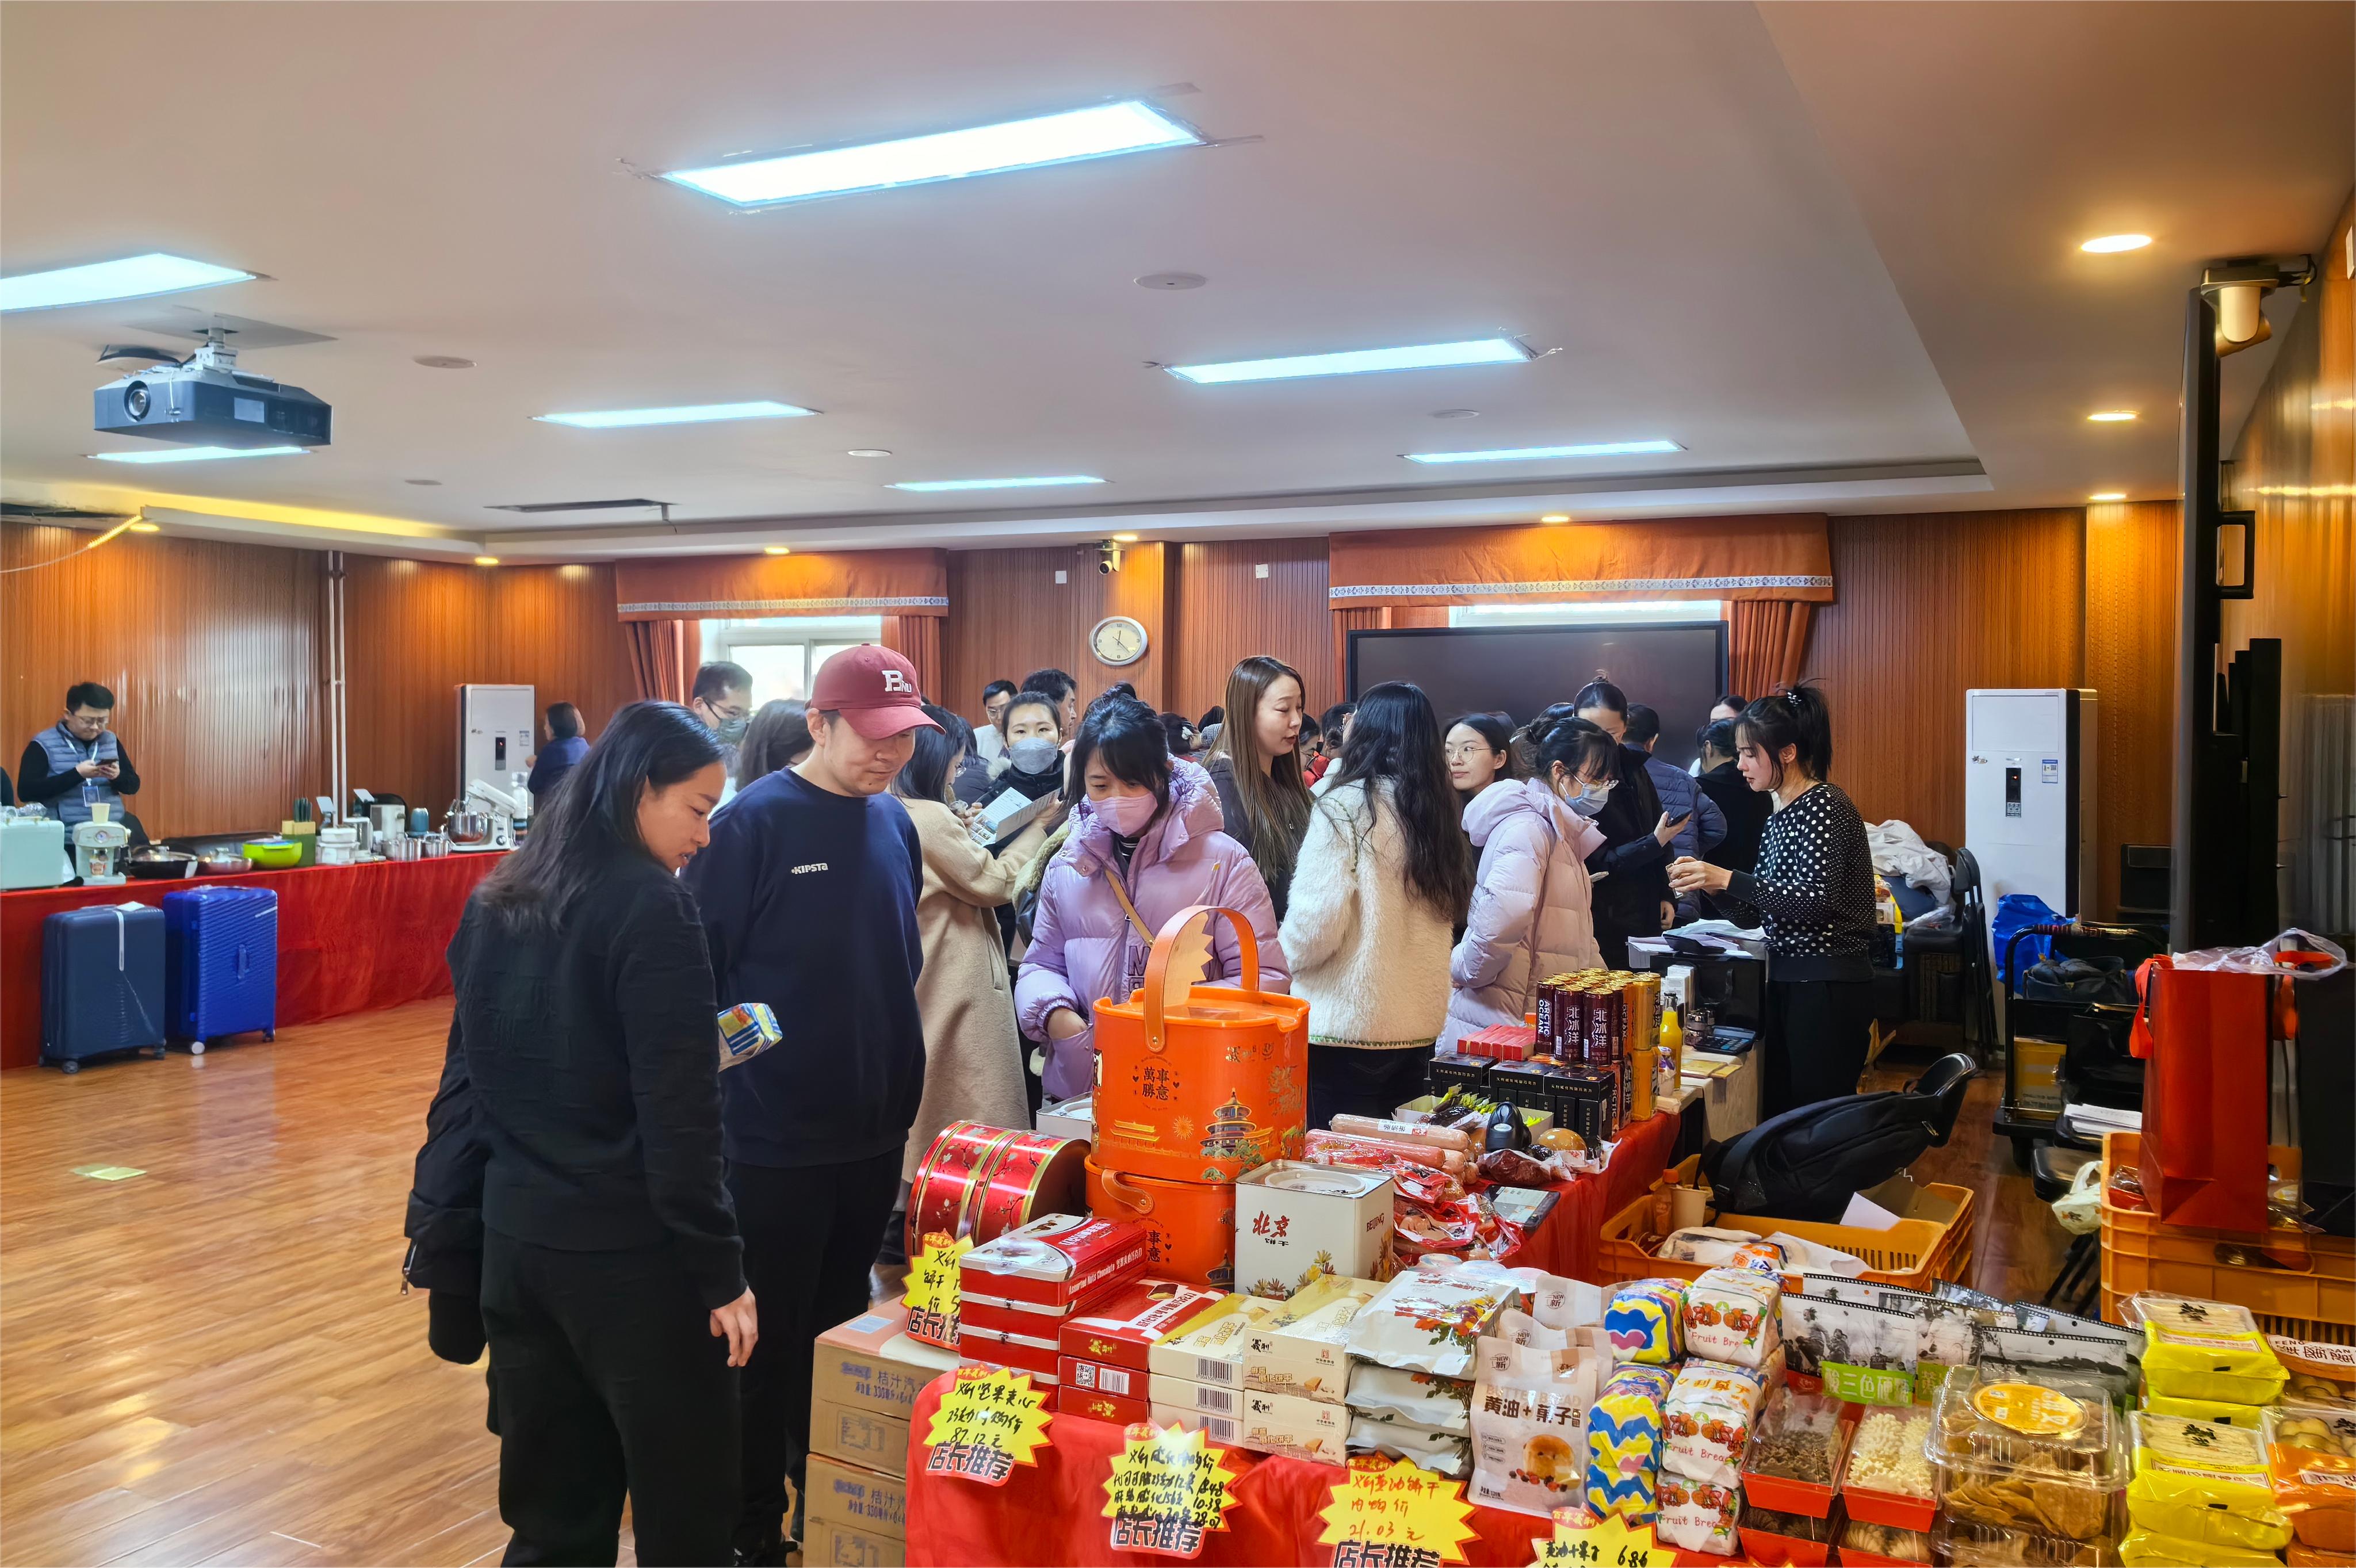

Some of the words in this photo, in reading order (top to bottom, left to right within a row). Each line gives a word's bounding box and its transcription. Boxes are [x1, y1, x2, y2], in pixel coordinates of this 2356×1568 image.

[1565, 1006, 1580, 1045] 北冰洋
[1592, 1008, 1608, 1047] 北冰洋
[1252, 1210, 1290, 1238] 北京
[1366, 1213, 1384, 1232] BEIJING
[1068, 1278, 1087, 1296] Assorted
[907, 1306, 960, 1345] 店长推
[1691, 1331, 1718, 1344] Fruit
[1486, 1384, 1534, 1403] BUTTE
[927, 1440, 1015, 1480] 店长推荐
[1700, 1448, 1726, 1462] Brea
[1351, 1497, 1409, 1518] 内购价
[1115, 1512, 1202, 1552] 店长推荐
[1334, 1539, 1441, 1568] 店长推荐
